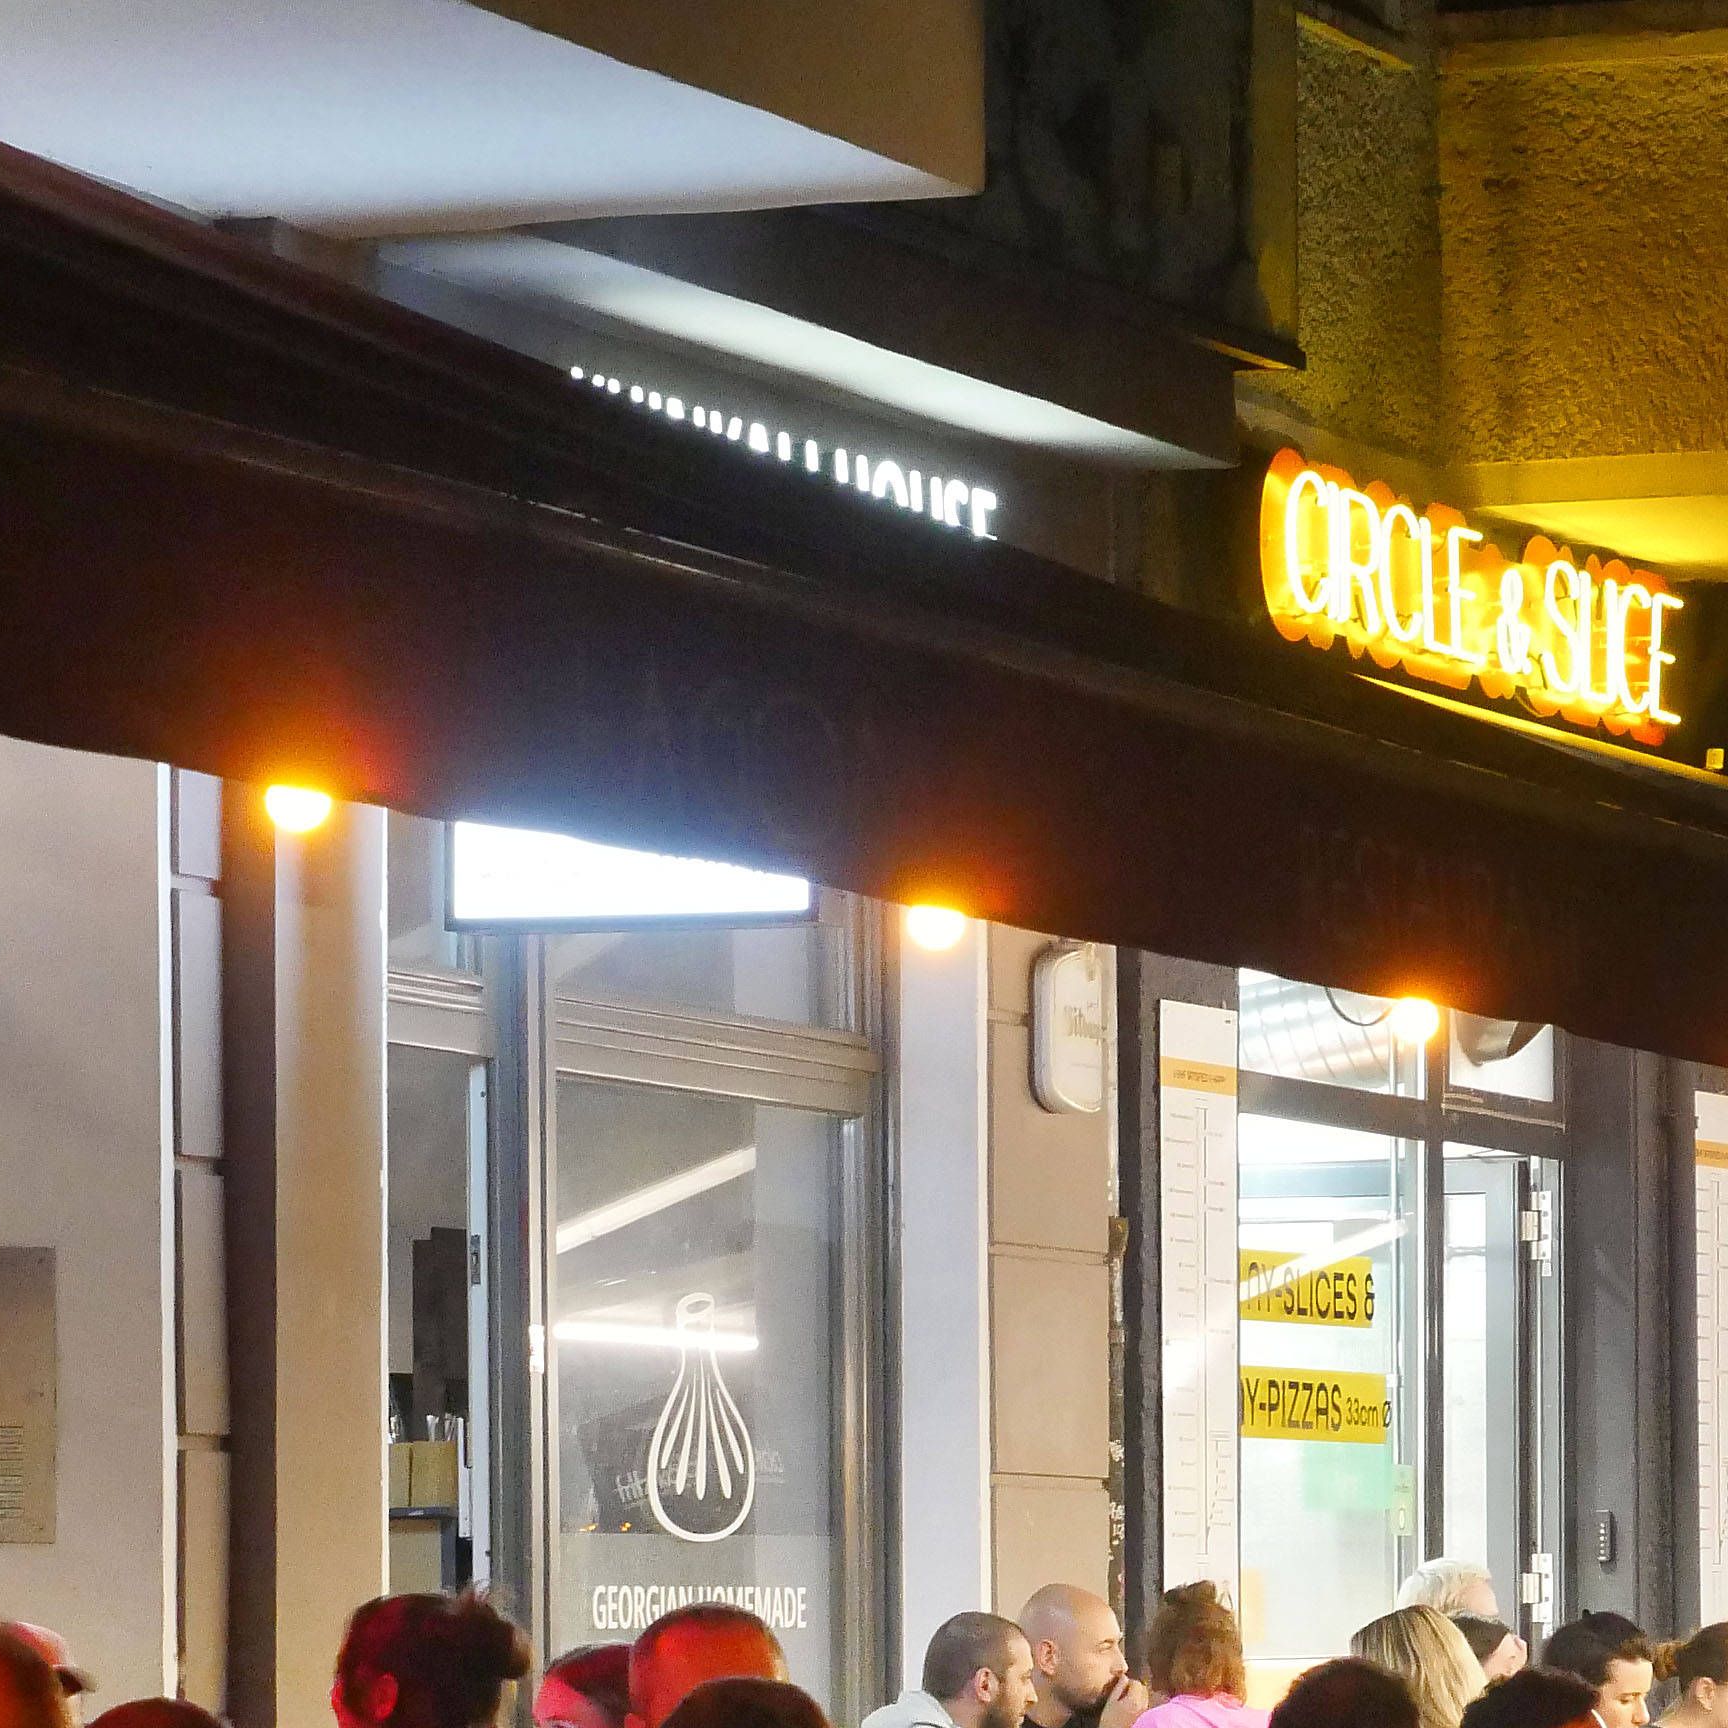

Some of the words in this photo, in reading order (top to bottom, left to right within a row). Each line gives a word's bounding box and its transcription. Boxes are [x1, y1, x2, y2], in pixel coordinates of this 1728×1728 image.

[1284, 470, 1487, 666] CIRCLE
[1496, 568, 1533, 675] &
[1540, 559, 1685, 725] SLICE
[1345, 1396, 1379, 1428] 33cm
